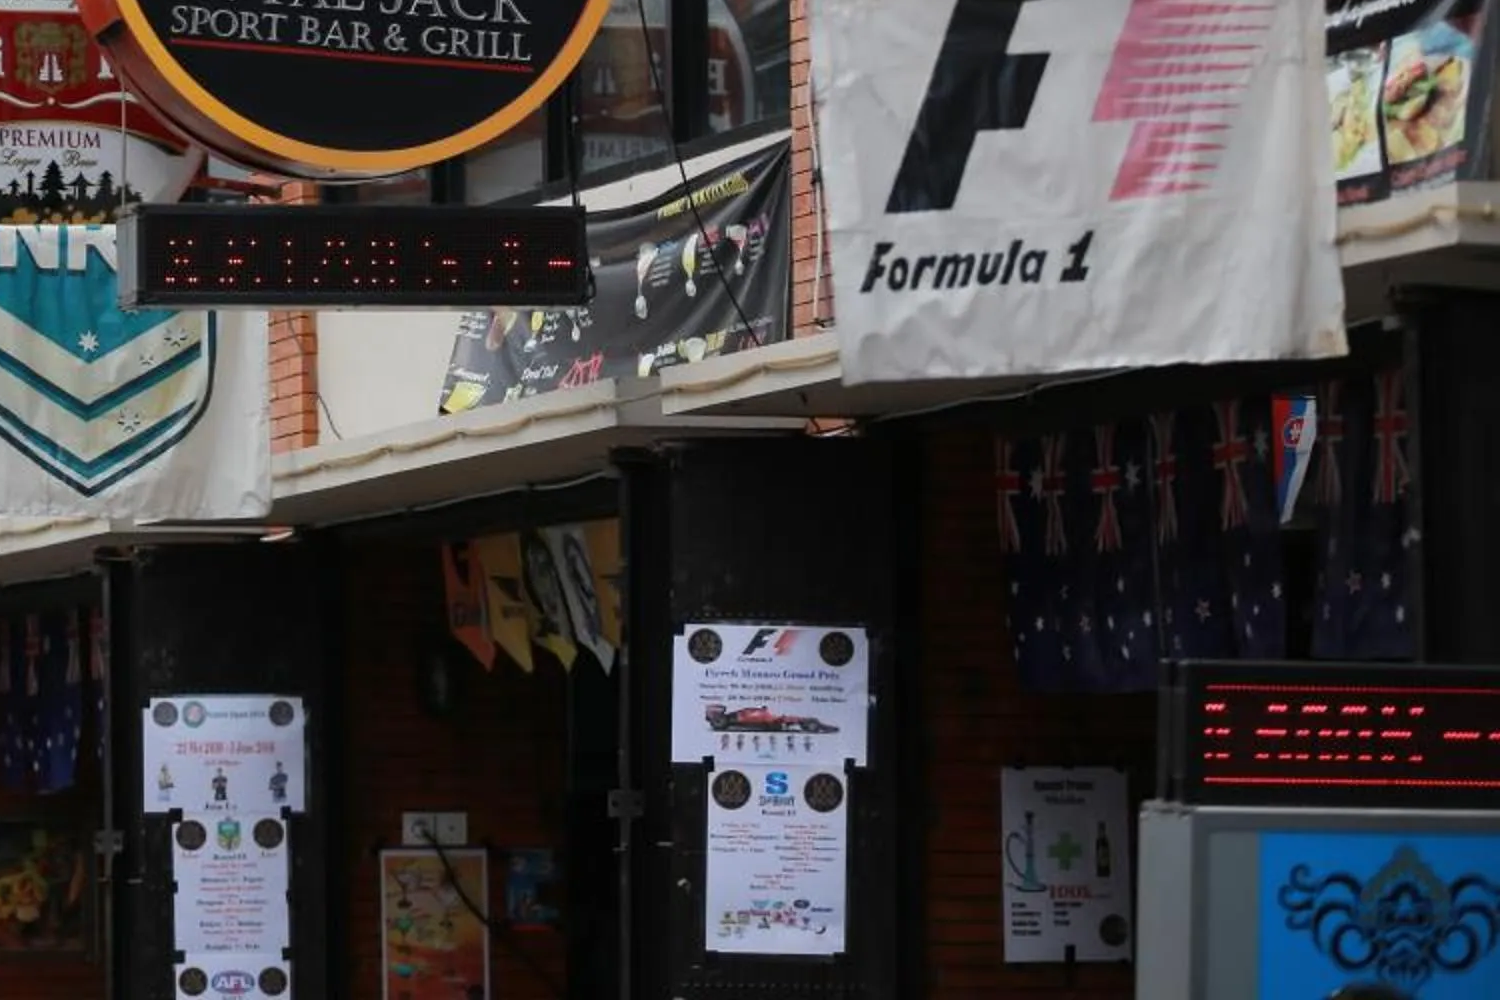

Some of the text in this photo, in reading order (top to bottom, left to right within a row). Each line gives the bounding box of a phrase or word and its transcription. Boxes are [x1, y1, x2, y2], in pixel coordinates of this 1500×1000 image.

[170, 5, 533, 61] SPORT BAR & GRILL
[0, 129, 101, 149] PREMIUM
[860, 230, 1094, 293] Formula 1
